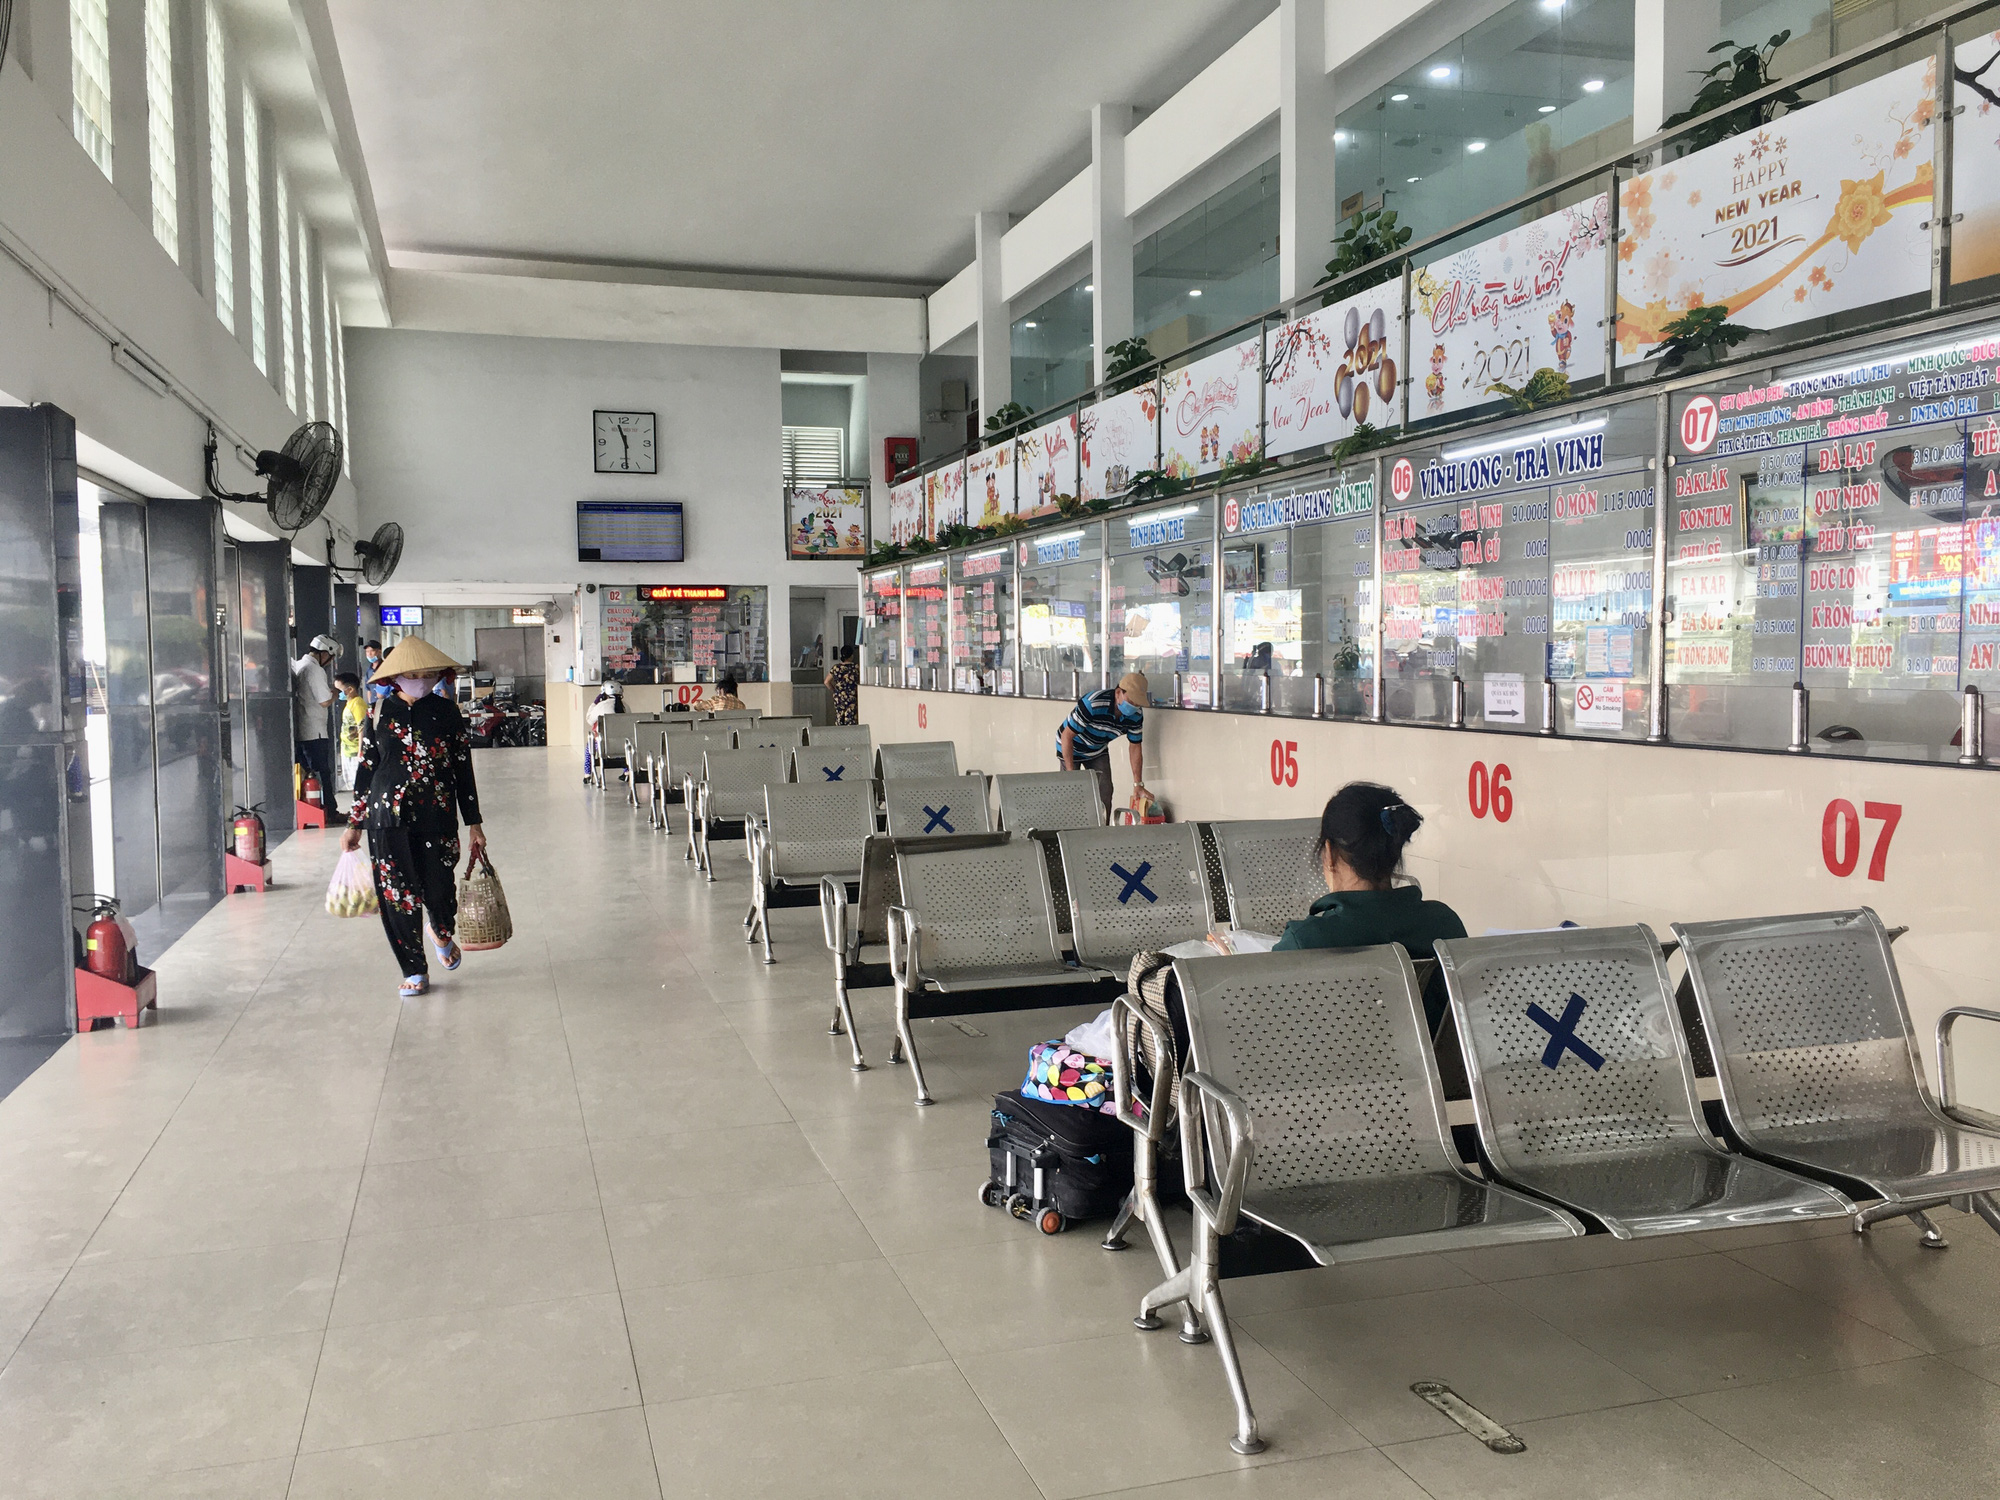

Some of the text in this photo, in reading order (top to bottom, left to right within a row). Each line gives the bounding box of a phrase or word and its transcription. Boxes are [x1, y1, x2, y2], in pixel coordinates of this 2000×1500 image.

[1732, 157, 1788, 194] HAPPY
[1715, 180, 1802, 224] NEW YEAR
[1731, 215, 1778, 254] 2021
[1343, 336, 1387, 378] 2021
[1473, 337, 1530, 388] 2021
[1290, 378, 1316, 400] HAPPY
[1720, 395, 1736, 411] CTY
[1790, 378, 1819, 398] TRỌNG
[1907, 354, 1934, 374] MINH
[1268, 397, 1331, 435] New Year
[1719, 366, 1989, 433] CTY MINH PHƯƠNG AN BÌNH THÀNH ANH VIỆT TÂN PHÁT
[618, 417, 630, 425] 12
[1684, 405, 1714, 446] 07
[1717, 438, 1734, 455] HTX
[1777, 426, 1807, 445] THANH
[1827, 413, 1859, 437] THỐNG
[1860, 406, 1889, 432] NHẤT
[1910, 404, 1940, 423] DNTN
[1957, 396, 1978, 415] HAI
[1972, 416, 2000, 456] TIỀ
[598, 438, 607, 446] 9
[643, 440, 652, 448] 3
[1818, 439, 1877, 473] ĐÀ LẠT
[620, 461, 629, 470] 6
[1393, 465, 1412, 493] 06
[1419, 434, 1605, 499] VĨNH LONG TRÀ VINH
[815, 506, 843, 518] 2021
[1303, 489, 1332, 521] GIANG
[1354, 474, 1375, 513] THƠ
[1512, 501, 1548, 522] 90.000đ
[1566, 484, 1599, 517] MÔN
[1603, 486, 1654, 512] 115.000đ
[1815, 478, 1882, 517] QUY NHƠN
[1168, 517, 1185, 543] TRE
[1225, 504, 1239, 527] 05
[1460, 501, 1503, 532] TRÀ VINH
[1679, 504, 1733, 531] KONTUM
[1067, 539, 1080, 560] TRE
[1461, 531, 1501, 565] TRÀ CÚ
[1817, 520, 1845, 553] PHÚ
[1847, 519, 1875, 551] YÊN
[1505, 577, 1548, 597] 100.000đ
[1681, 575, 1726, 596] EA KAR
[1809, 562, 1837, 592] ĐỨC
[609, 591, 620, 601] 02
[1804, 637, 1894, 672] BUÔN MA THUỘT
[678, 685, 703, 705] 02
[917, 703, 927, 729] 03
[1270, 739, 1299, 788] 05
[1468, 761, 1513, 823] 06
[1821, 798, 1902, 882] 07
